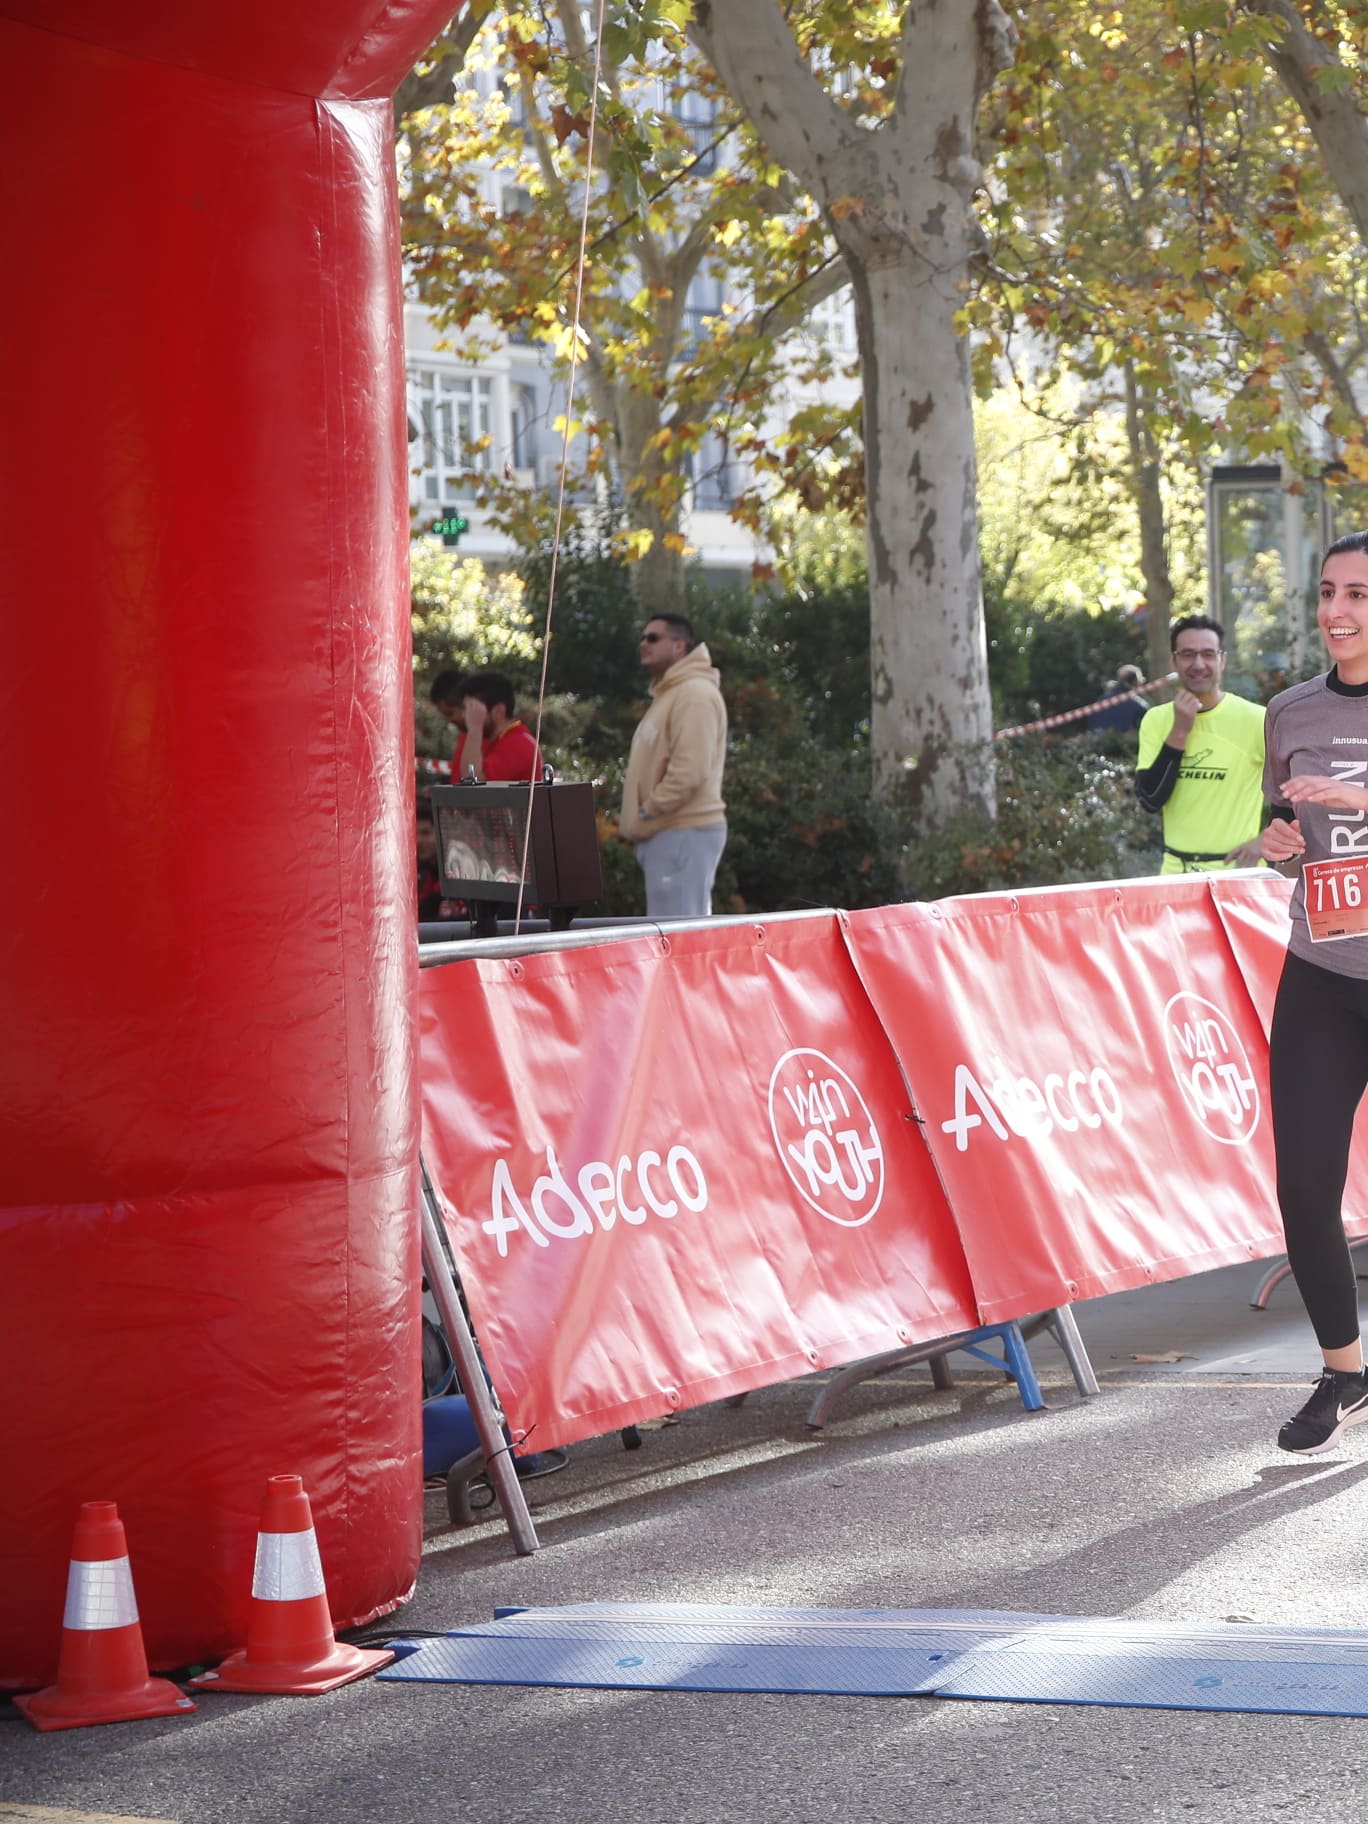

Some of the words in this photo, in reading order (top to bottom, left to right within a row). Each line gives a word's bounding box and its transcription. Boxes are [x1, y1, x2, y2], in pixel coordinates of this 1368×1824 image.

[1313, 873, 1361, 911] 716
[941, 1056, 1123, 1152] Adecco
[482, 1144, 708, 1257] Adecco
